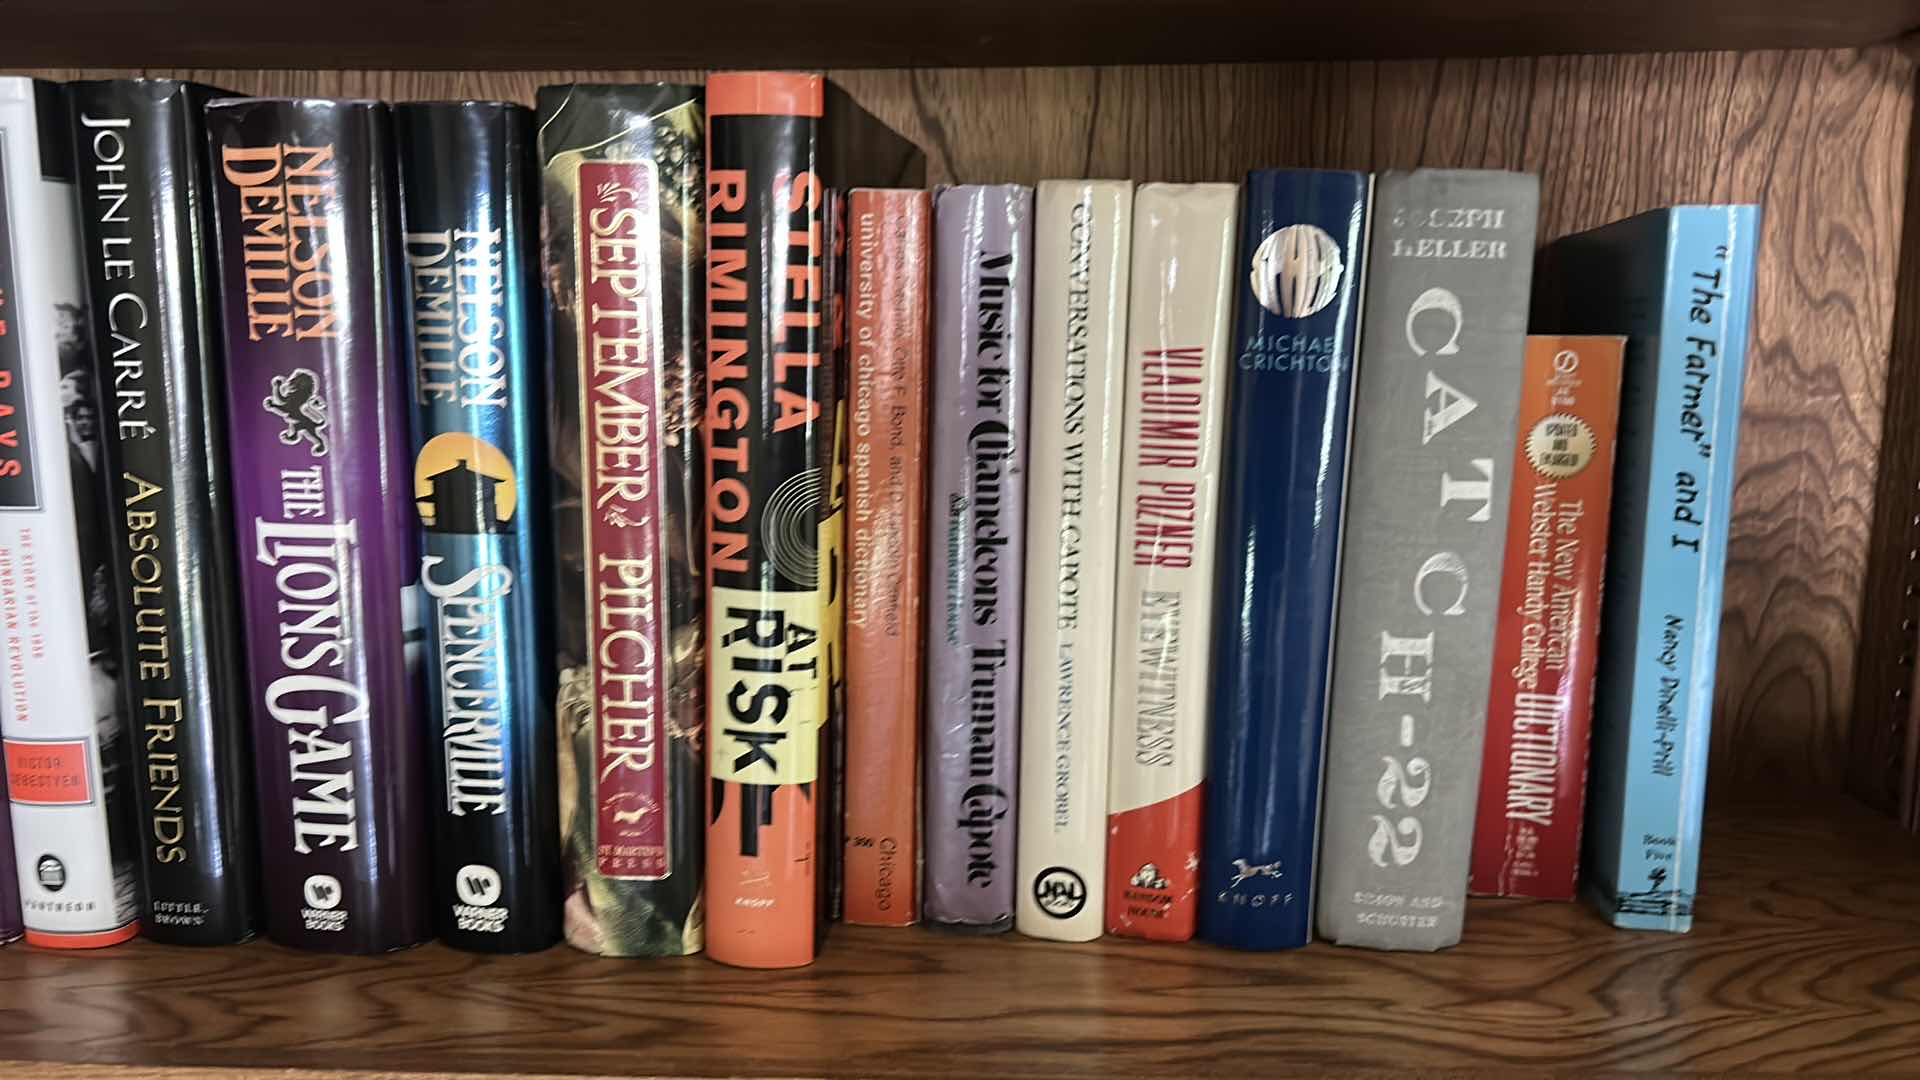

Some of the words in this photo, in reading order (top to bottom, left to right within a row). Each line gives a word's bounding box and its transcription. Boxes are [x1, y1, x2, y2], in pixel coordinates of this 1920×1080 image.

[81, 112, 132, 224] JOHN
[103, 236, 136, 281] LE
[222, 143, 295, 342] DEMILLE
[284, 143, 339, 342] NELSON
[855, 212, 879, 320] university
[405, 229, 458, 406] DEMILLE
[454, 228, 508, 409] NELSON
[772, 166, 825, 433] STELLA
[858, 326, 877, 348] of
[977, 250, 1012, 361] Music
[1063, 202, 1093, 435] CONVERSATIONS
[1245, 335, 1342, 353] MICHAE
[108, 292, 158, 441] CARRÉ
[589, 207, 655, 512] SEPTEMBER
[707, 168, 752, 573] RIMINGTON
[854, 354, 876, 436] chicago
[975, 366, 1010, 413] for
[1137, 347, 1204, 468] VLADIMIR
[282, 465, 326, 520] THE
[853, 442, 874, 522] spanish
[888, 456, 903, 487] and
[966, 420, 1012, 628] Chameleons
[1062, 445, 1084, 520] WITH
[1528, 483, 1558, 555] Webster
[1557, 499, 1585, 535] The
[1674, 470, 1701, 526] and
[123, 471, 172, 682] ABSOLUTE
[1133, 480, 1196, 570] POZNER
[1553, 538, 1580, 580] New
[1672, 534, 1700, 553] I
[848, 527, 873, 630] dictionary
[1057, 527, 1083, 632] CAPOTE
[1516, 561, 1552, 622] Handy
[1545, 584, 1579, 670] American
[420, 554, 513, 818] SPENCERVILLE
[599, 551, 656, 784] PILCHER
[723, 607, 791, 776] RISK
[785, 622, 819, 683] AT
[1056, 643, 1074, 750] LAWRENCE
[1136, 590, 1181, 769] EYEWITNESS
[1512, 623, 1547, 690] College
[1655, 614, 1685, 673] Nancy
[969, 639, 1007, 778] Truman
[1506, 692, 1563, 826] DICTIONARY
[143, 695, 188, 865] FRIENDS
[264, 673, 371, 856] GAME
[1054, 753, 1071, 828] GROBEL
[873, 836, 897, 911] Chicago
[957, 783, 1008, 889] Capote
